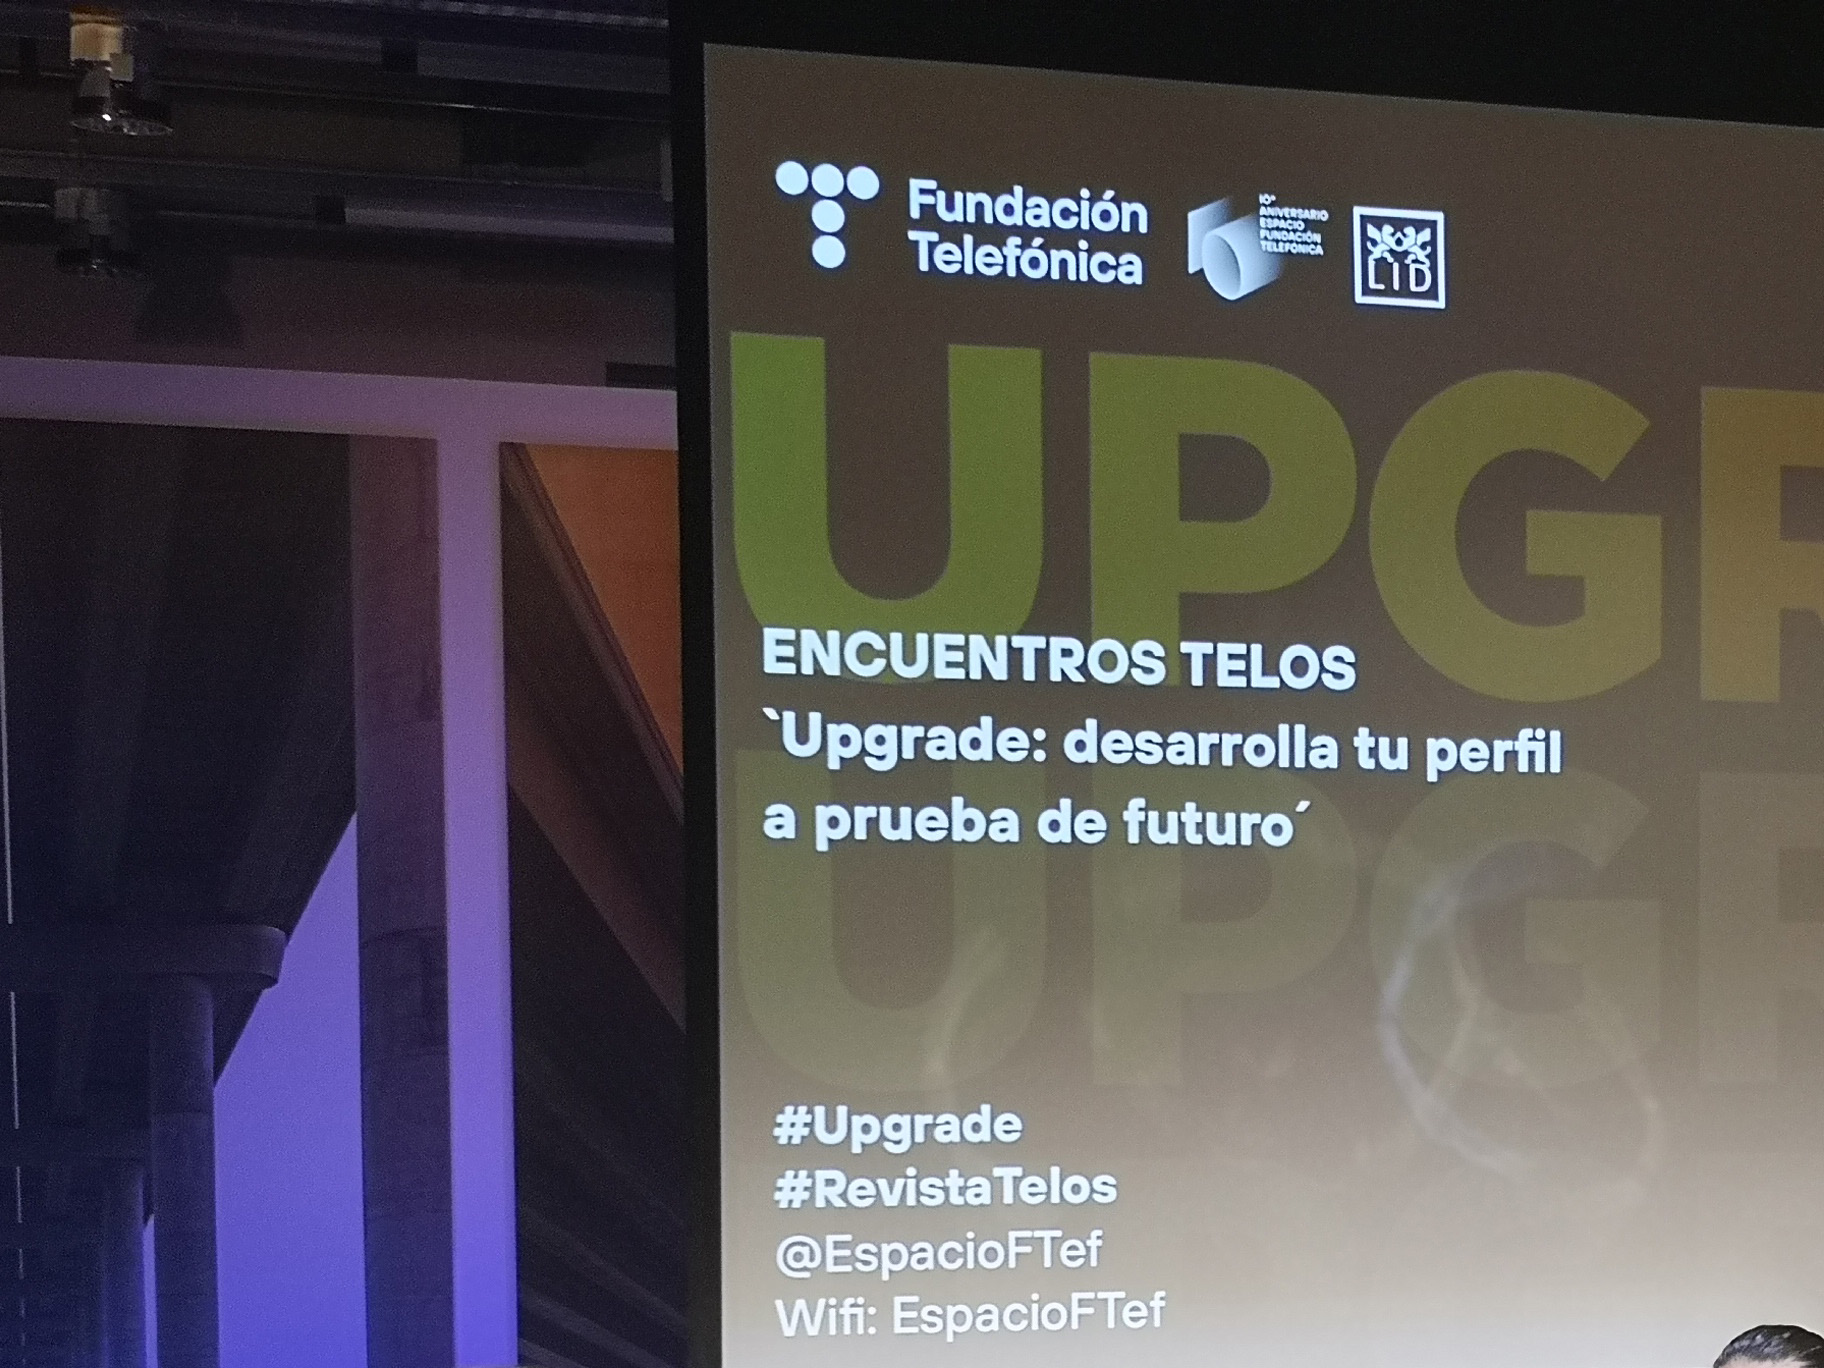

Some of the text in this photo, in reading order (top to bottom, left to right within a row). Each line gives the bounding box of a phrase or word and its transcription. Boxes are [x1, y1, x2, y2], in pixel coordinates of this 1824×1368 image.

[907, 177, 1149, 236] Fundación
[1258, 205, 1330, 222] ANIVERSARIO
[1259, 217, 1306, 231] ESPACIO
[907, 230, 1144, 286] Telefónica
[1259, 228, 1322, 244] FUNDACIÓN
[1260, 240, 1325, 257] TELEFÓNICA
[1367, 259, 1432, 293] LID
[762, 626, 1357, 692] ENCUENTROS TELOS
[1063, 716, 1339, 770] desarrolla
[1353, 725, 1410, 772] tu
[1426, 727, 1563, 783] perfil
[763, 802, 797, 840] a
[814, 795, 1021, 853] prueba
[1037, 797, 1108, 845] de
[772, 1102, 1024, 1155] #Upgrade
[773, 1164, 1119, 1210] #RevistaTelos
[775, 1229, 1104, 1282] @EspacioFTef
[774, 1290, 1168, 1343] Wifi: EspacioFTef
